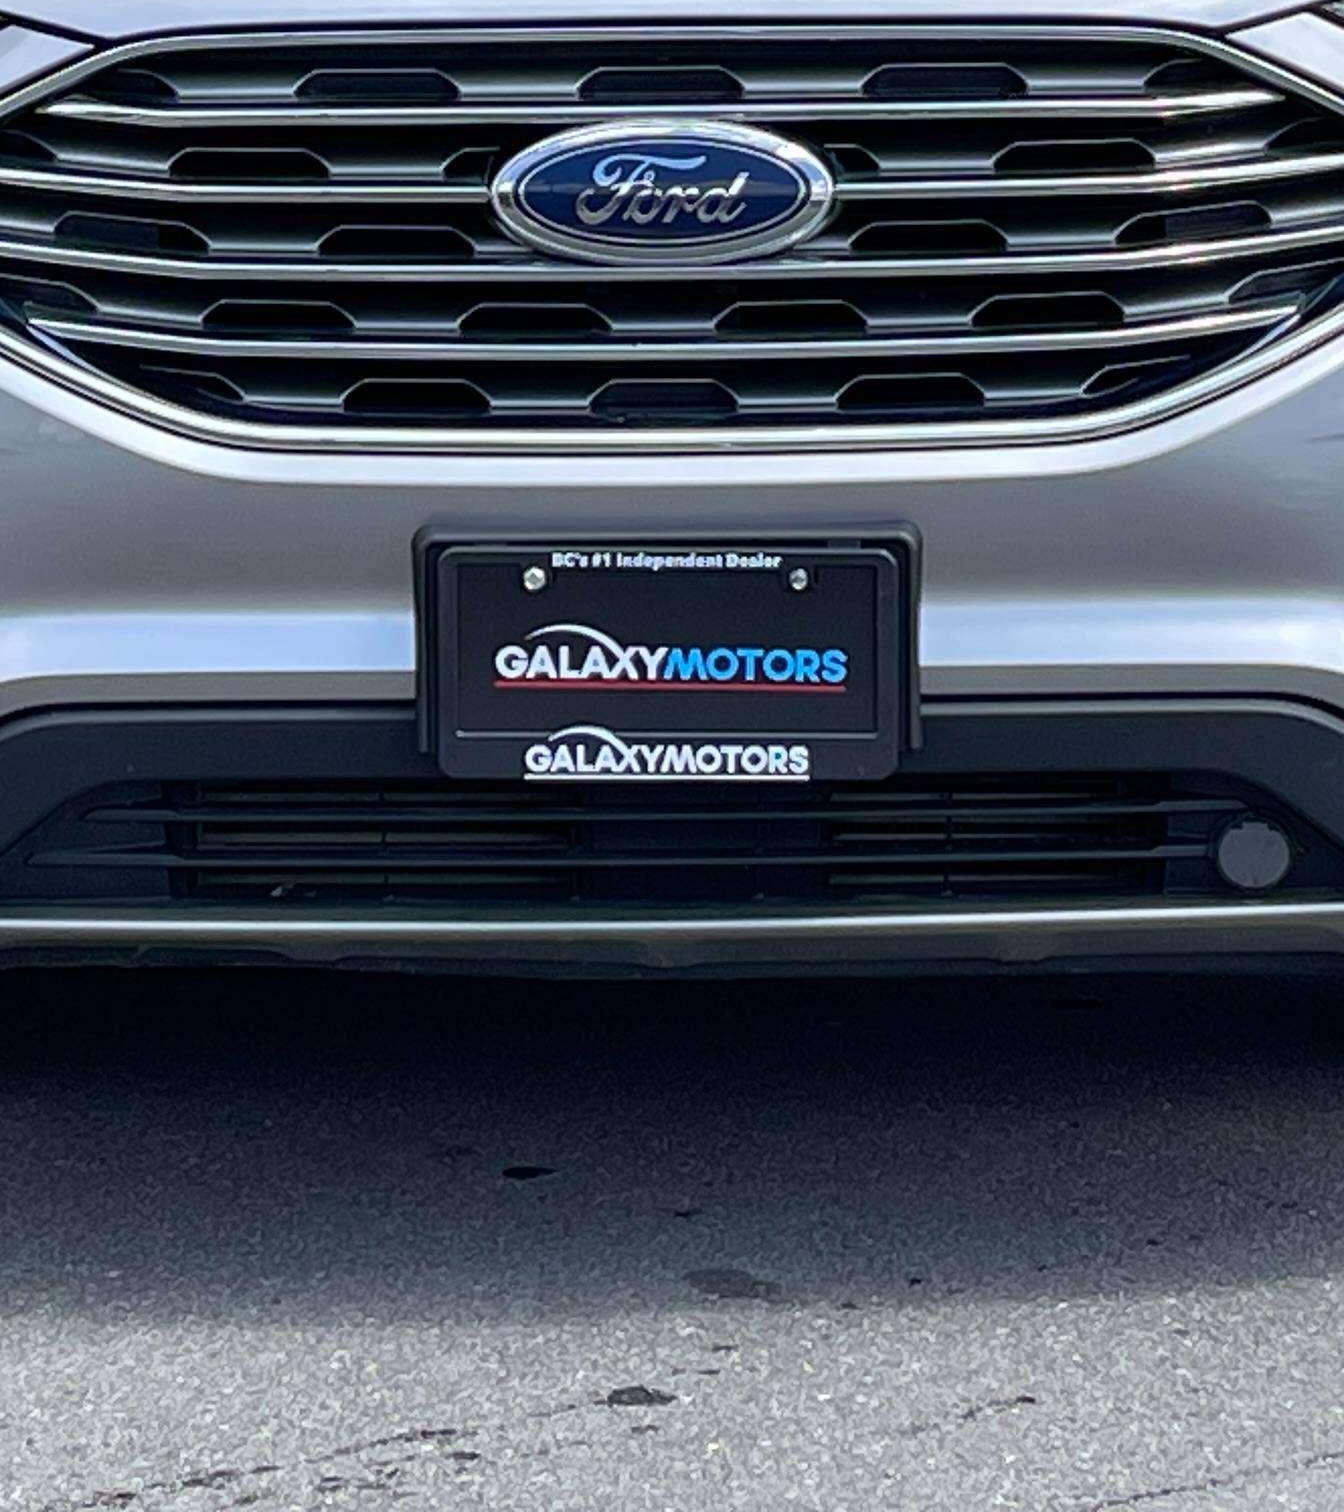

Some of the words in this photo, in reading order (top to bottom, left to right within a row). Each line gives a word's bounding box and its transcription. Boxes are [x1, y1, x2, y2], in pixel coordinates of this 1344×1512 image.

[575, 153, 750, 225] Ford
[551, 551, 589, 568] BC's
[591, 552, 612, 568] #1
[616, 552, 724, 572] Independent
[724, 552, 783, 569] Dealer
[524, 744, 810, 775] GALAXYMOTORS
